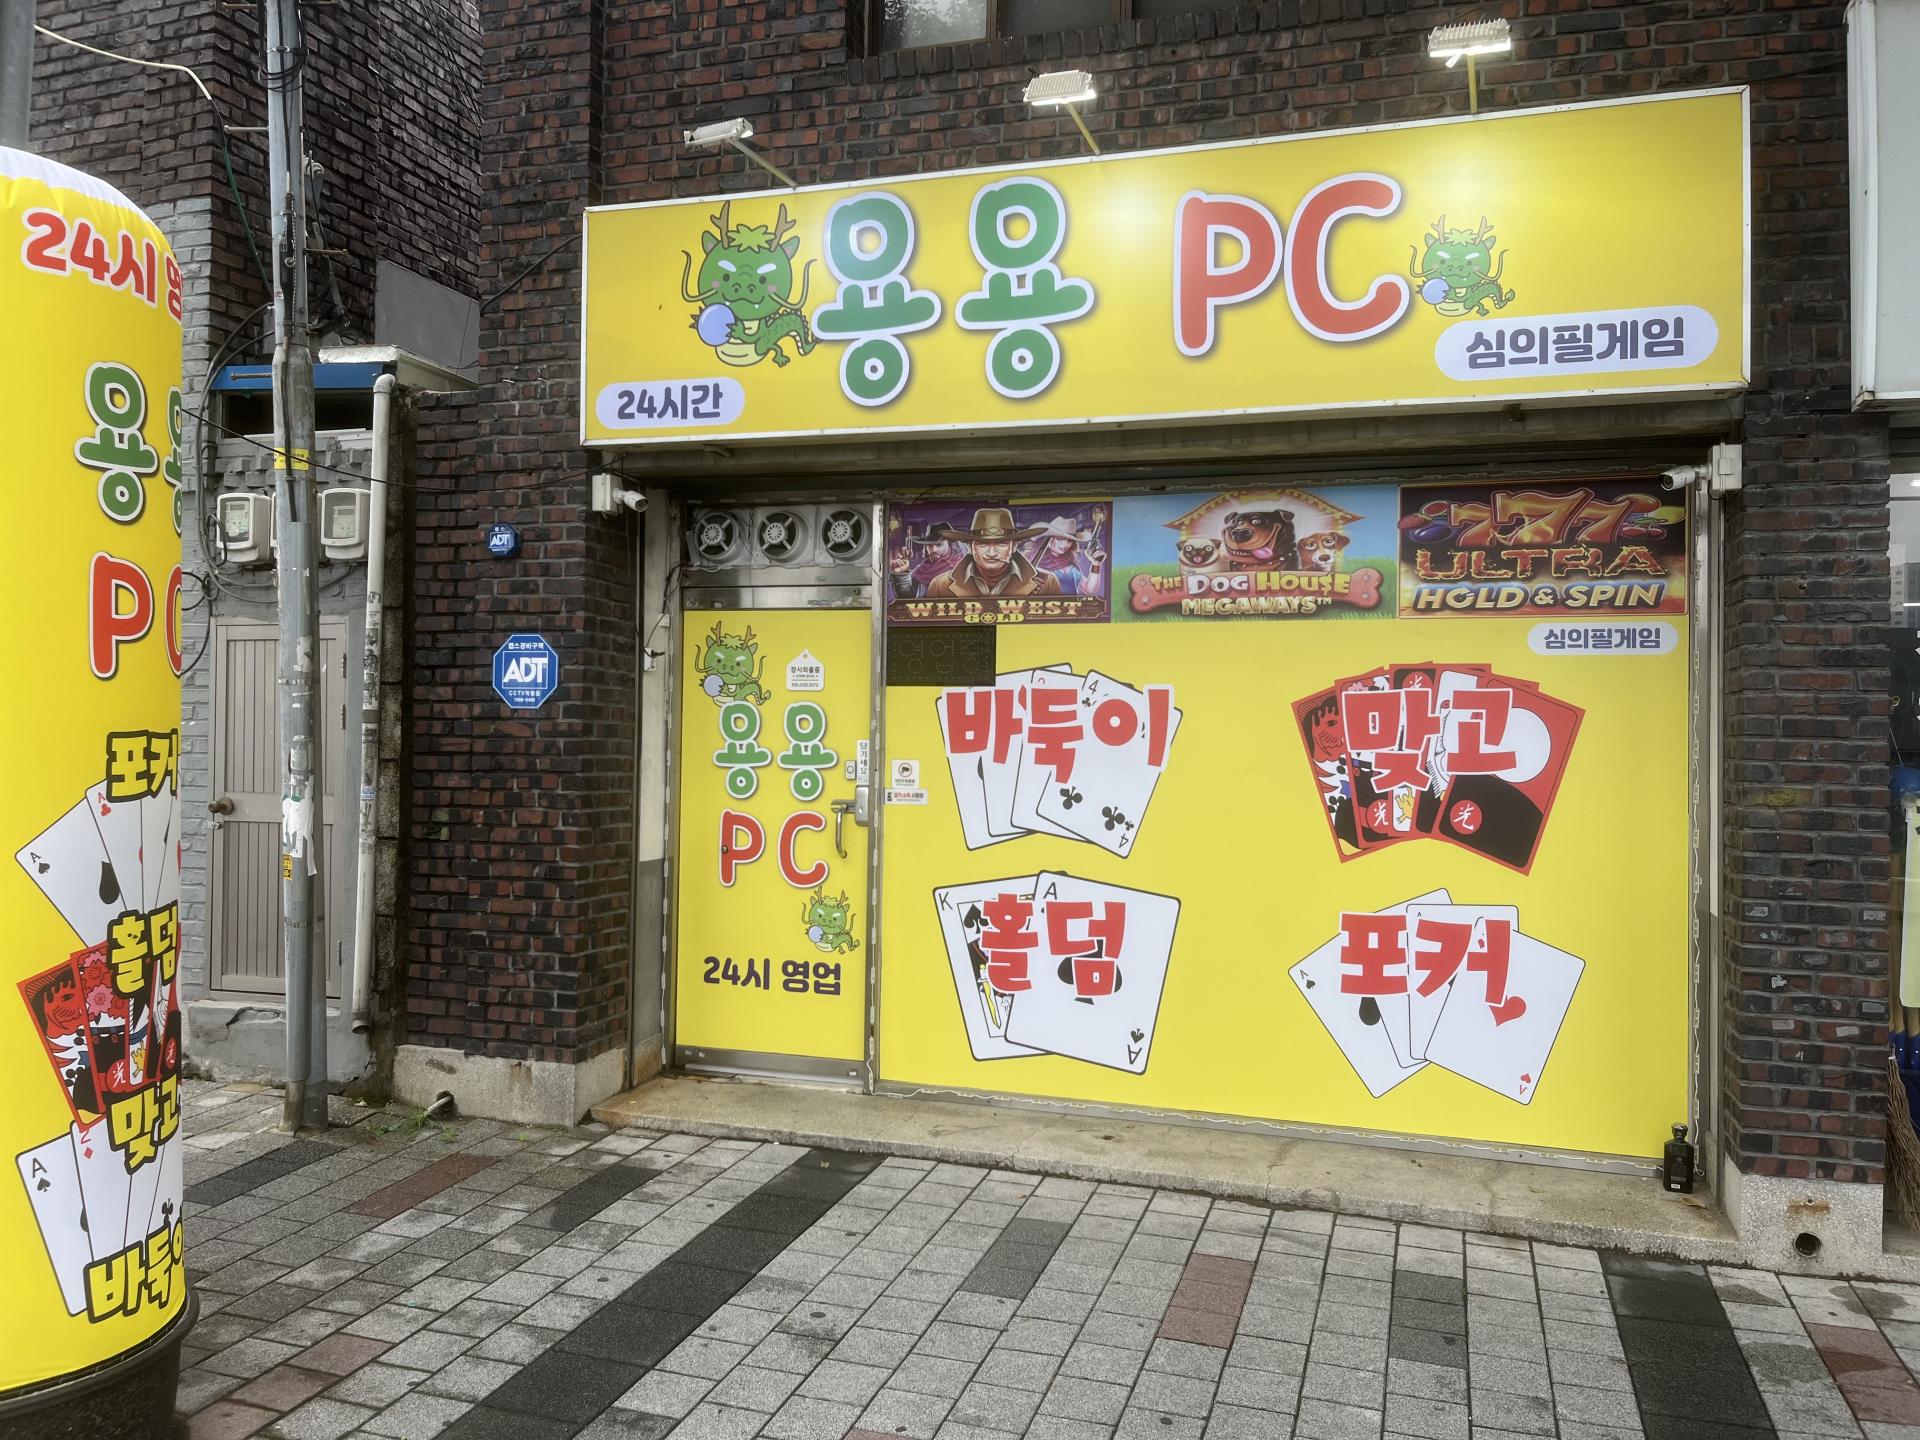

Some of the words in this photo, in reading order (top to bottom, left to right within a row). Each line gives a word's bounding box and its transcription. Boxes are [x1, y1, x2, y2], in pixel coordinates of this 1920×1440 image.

[22, 208, 157, 308] 24시
[812, 176, 1094, 406] 용용
[1174, 172, 1410, 356] PC
[1465, 316, 1684, 369] 심의필게임
[617, 384, 723, 420] 24시간
[490, 534, 509, 546] ADT
[1416, 545, 1667, 580] ULTRA
[1187, 575, 1250, 595] DOG
[1416, 586, 1525, 609] HOLD
[1533, 588, 1555, 606] &
[1565, 584, 1664, 608] SPIN
[906, 602, 983, 617] WILD
[963, 613, 1024, 624] GOLD
[1544, 628, 1661, 650] 심의필게임
[502, 656, 549, 683] ADT
[1088, 680, 1099, 695] 4
[713, 700, 838, 801] 용용
[945, 687, 1170, 785] 바둑이
[1342, 688, 1517, 792] 맞고
[30, 852, 42, 864] A
[719, 809, 829, 888] PC
[938, 891, 953, 911] K
[1043, 882, 1058, 900] A
[108, 901, 178, 997] 홀덤
[981, 893, 1126, 996] 홀덤
[1340, 912, 1512, 1005] 포커
[703, 956, 771, 991] 24시
[781, 960, 841, 996] 영업
[1127, 1045, 1143, 1065] A
[106, 1071, 179, 1174] 맞고
[31, 1157, 48, 1178] A
